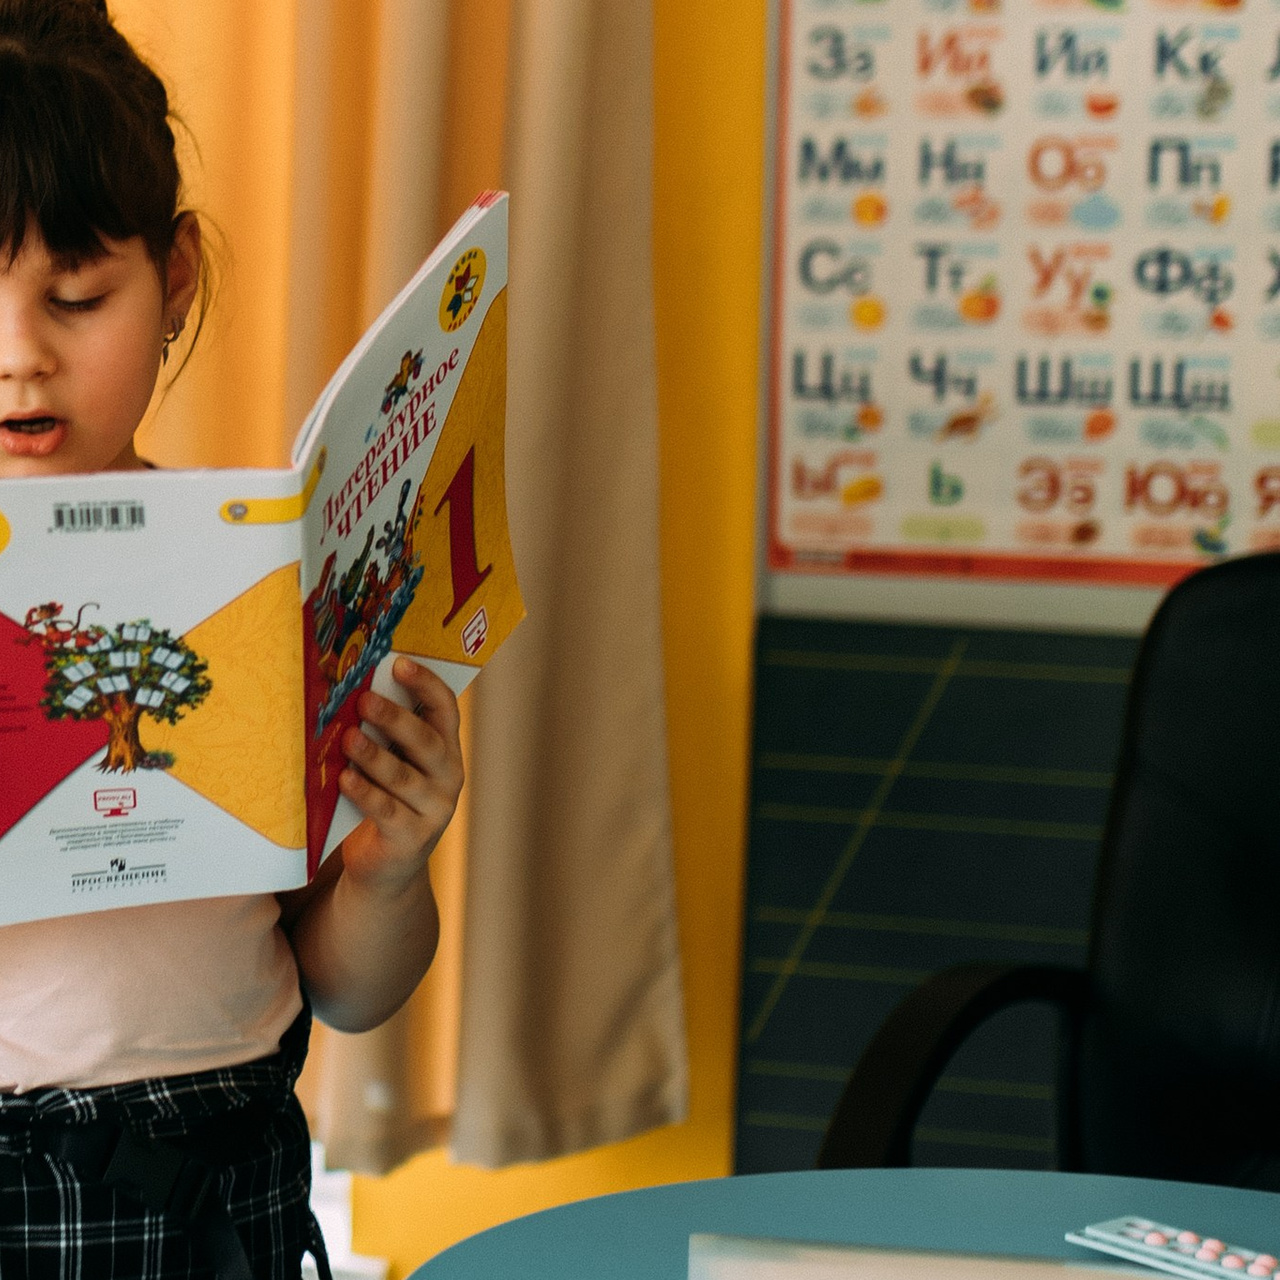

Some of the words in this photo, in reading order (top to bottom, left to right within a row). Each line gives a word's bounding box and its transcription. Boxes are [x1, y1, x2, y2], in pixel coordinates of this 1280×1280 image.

[807, 27, 875, 82] Зз
[798, 136, 886, 188] Мм
[1027, 135, 1107, 191] Оо
[1148, 138, 1222, 188] Пп
[798, 238, 872, 295] Сс
[916, 241, 967, 293] Тт
[1134, 246, 1235, 303] Фф
[336, 401, 438, 541] ЧТЕНИЕ
[434, 444, 493, 629] 1
